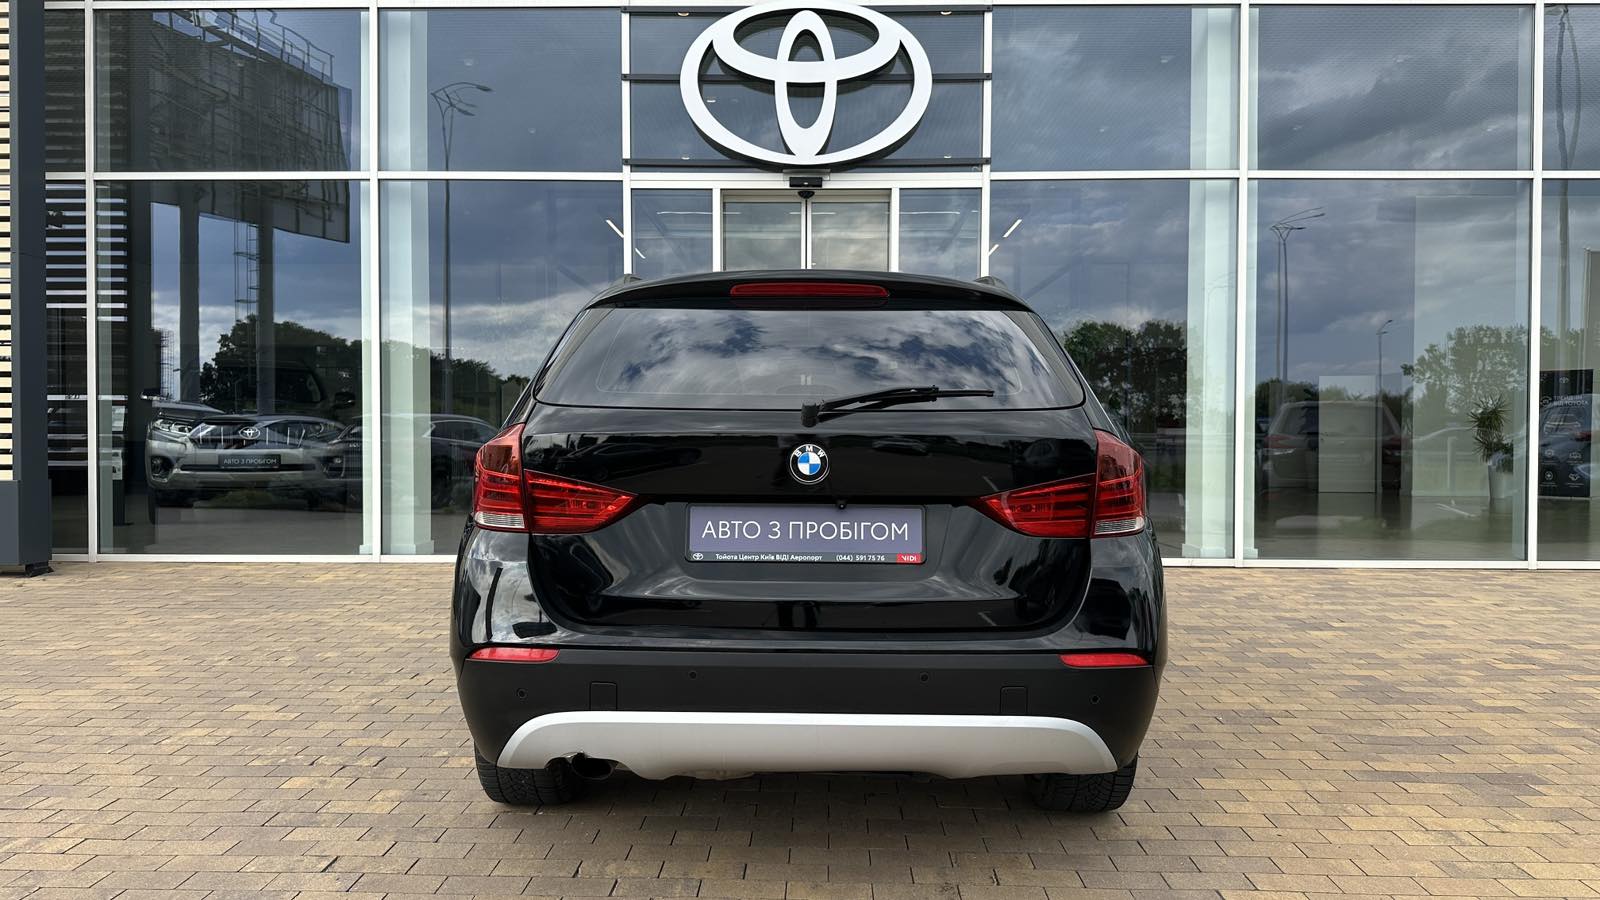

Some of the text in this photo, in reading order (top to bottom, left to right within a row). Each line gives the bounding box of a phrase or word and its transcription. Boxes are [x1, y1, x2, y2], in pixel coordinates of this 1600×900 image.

[794, 445, 825, 457] BMW
[701, 520, 908, 541] АВТО З ПРОБІГОМ
[739, 553, 760, 561] Центр
[790, 554, 822, 562] Аеропорт
[836, 554, 853, 562] (044)
